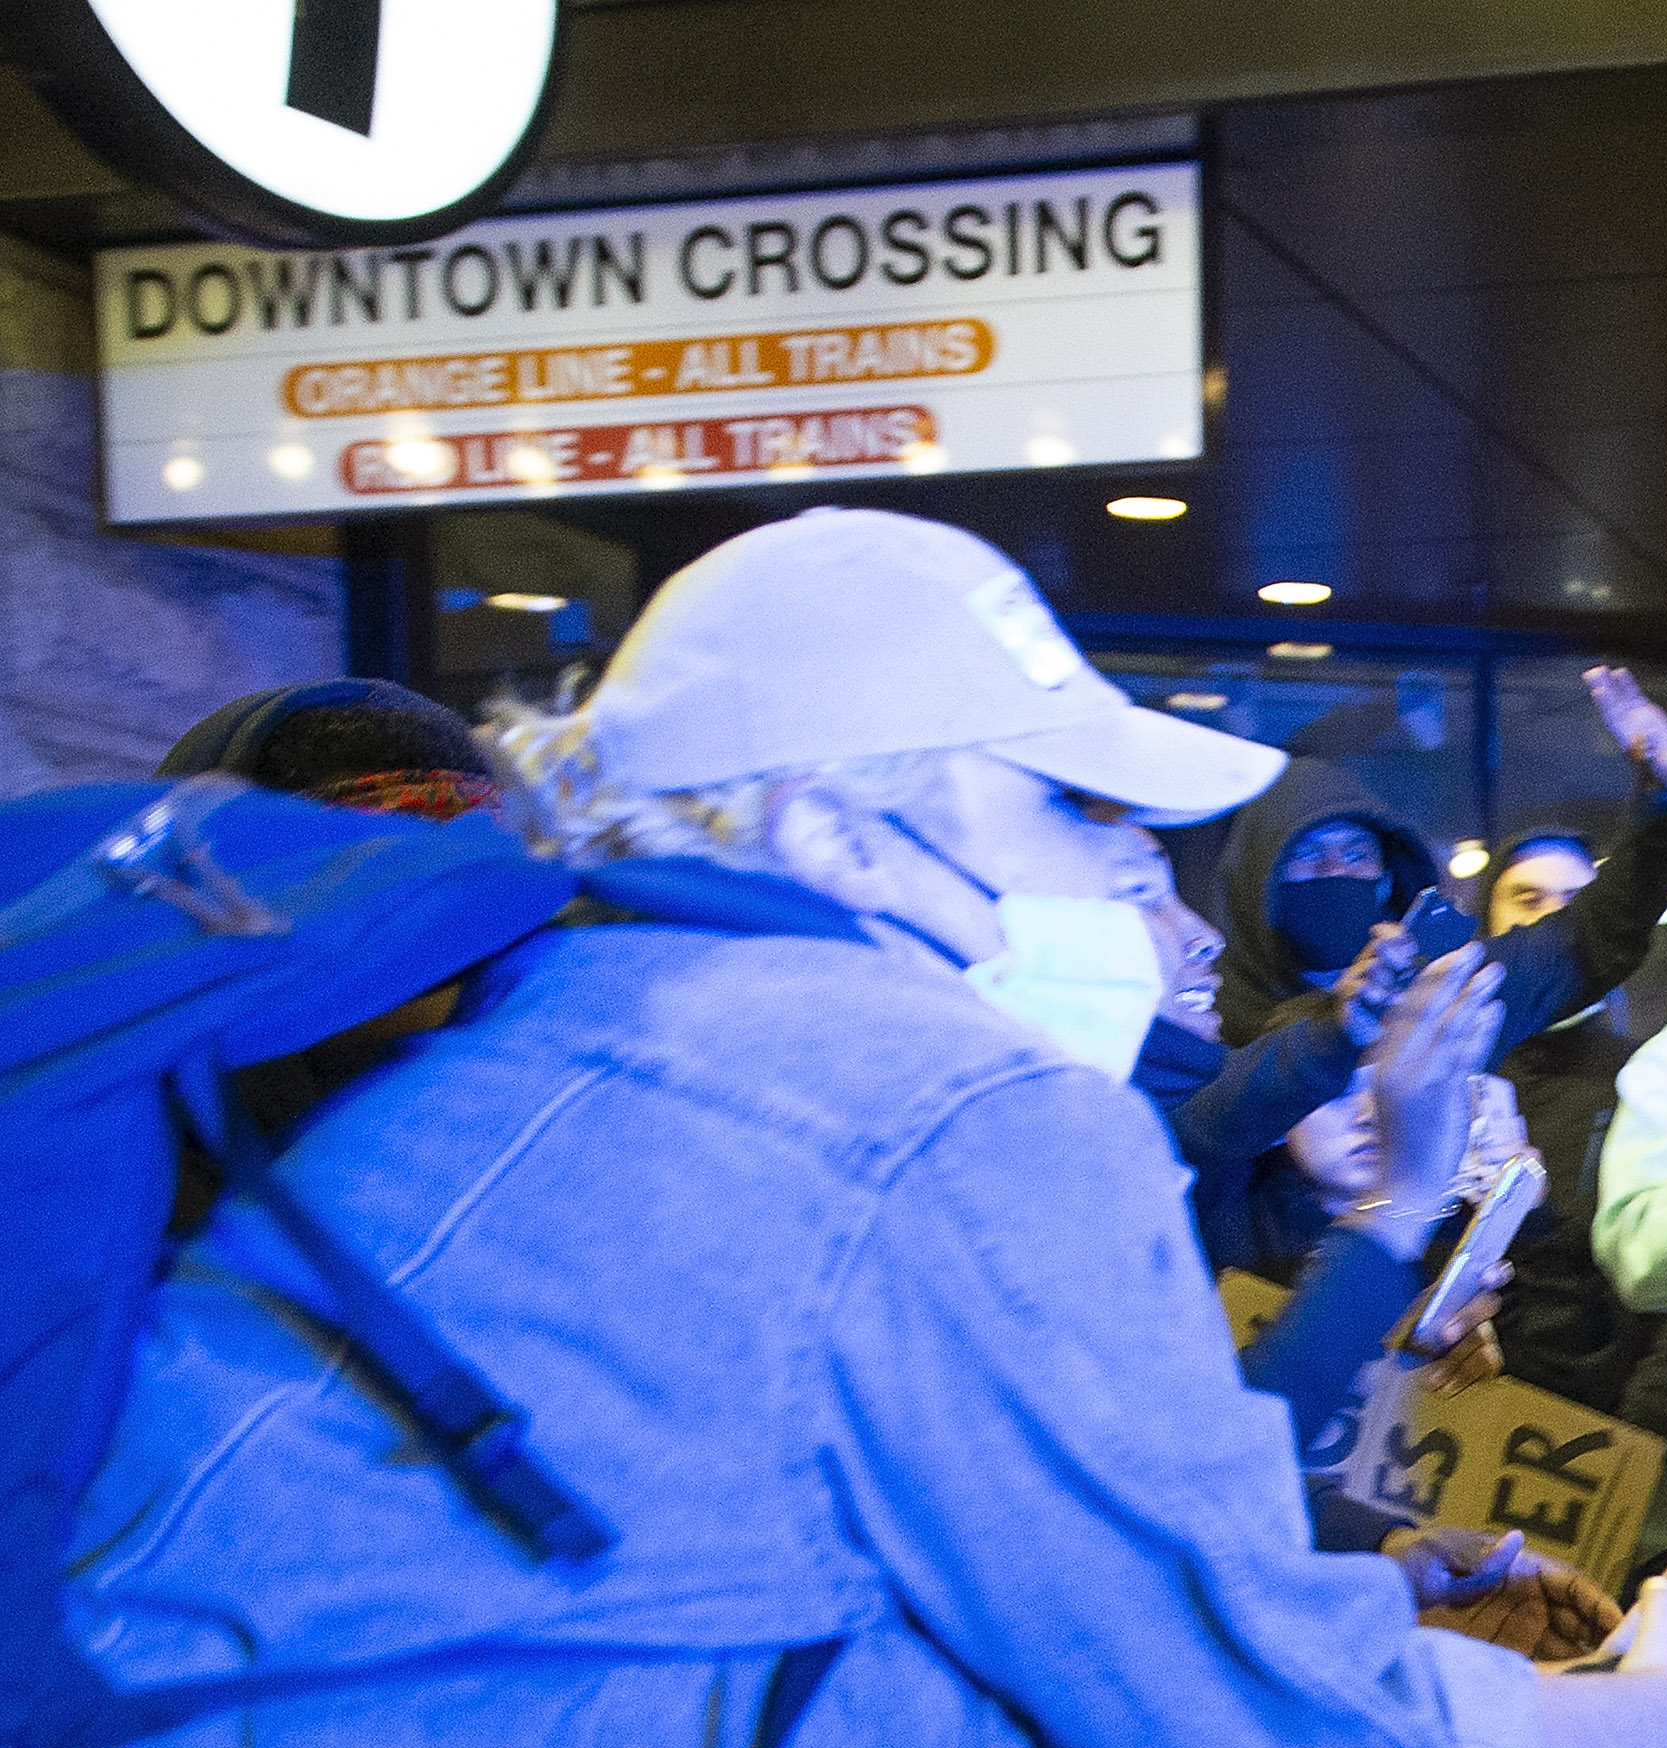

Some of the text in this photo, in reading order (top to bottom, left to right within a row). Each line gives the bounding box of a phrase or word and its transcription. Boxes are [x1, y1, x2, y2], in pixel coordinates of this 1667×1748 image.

[126, 190, 1161, 340] DOWNTOWN CROSSING
[303, 352, 508, 413] ORANGE
[516, 346, 635, 398] LINE
[674, 337, 775, 391] ALL
[781, 322, 980, 385] TRAINS
[466, 430, 580, 484] LIE
[621, 427, 716, 476] ALL
[723, 408, 920, 463] TRAINS
